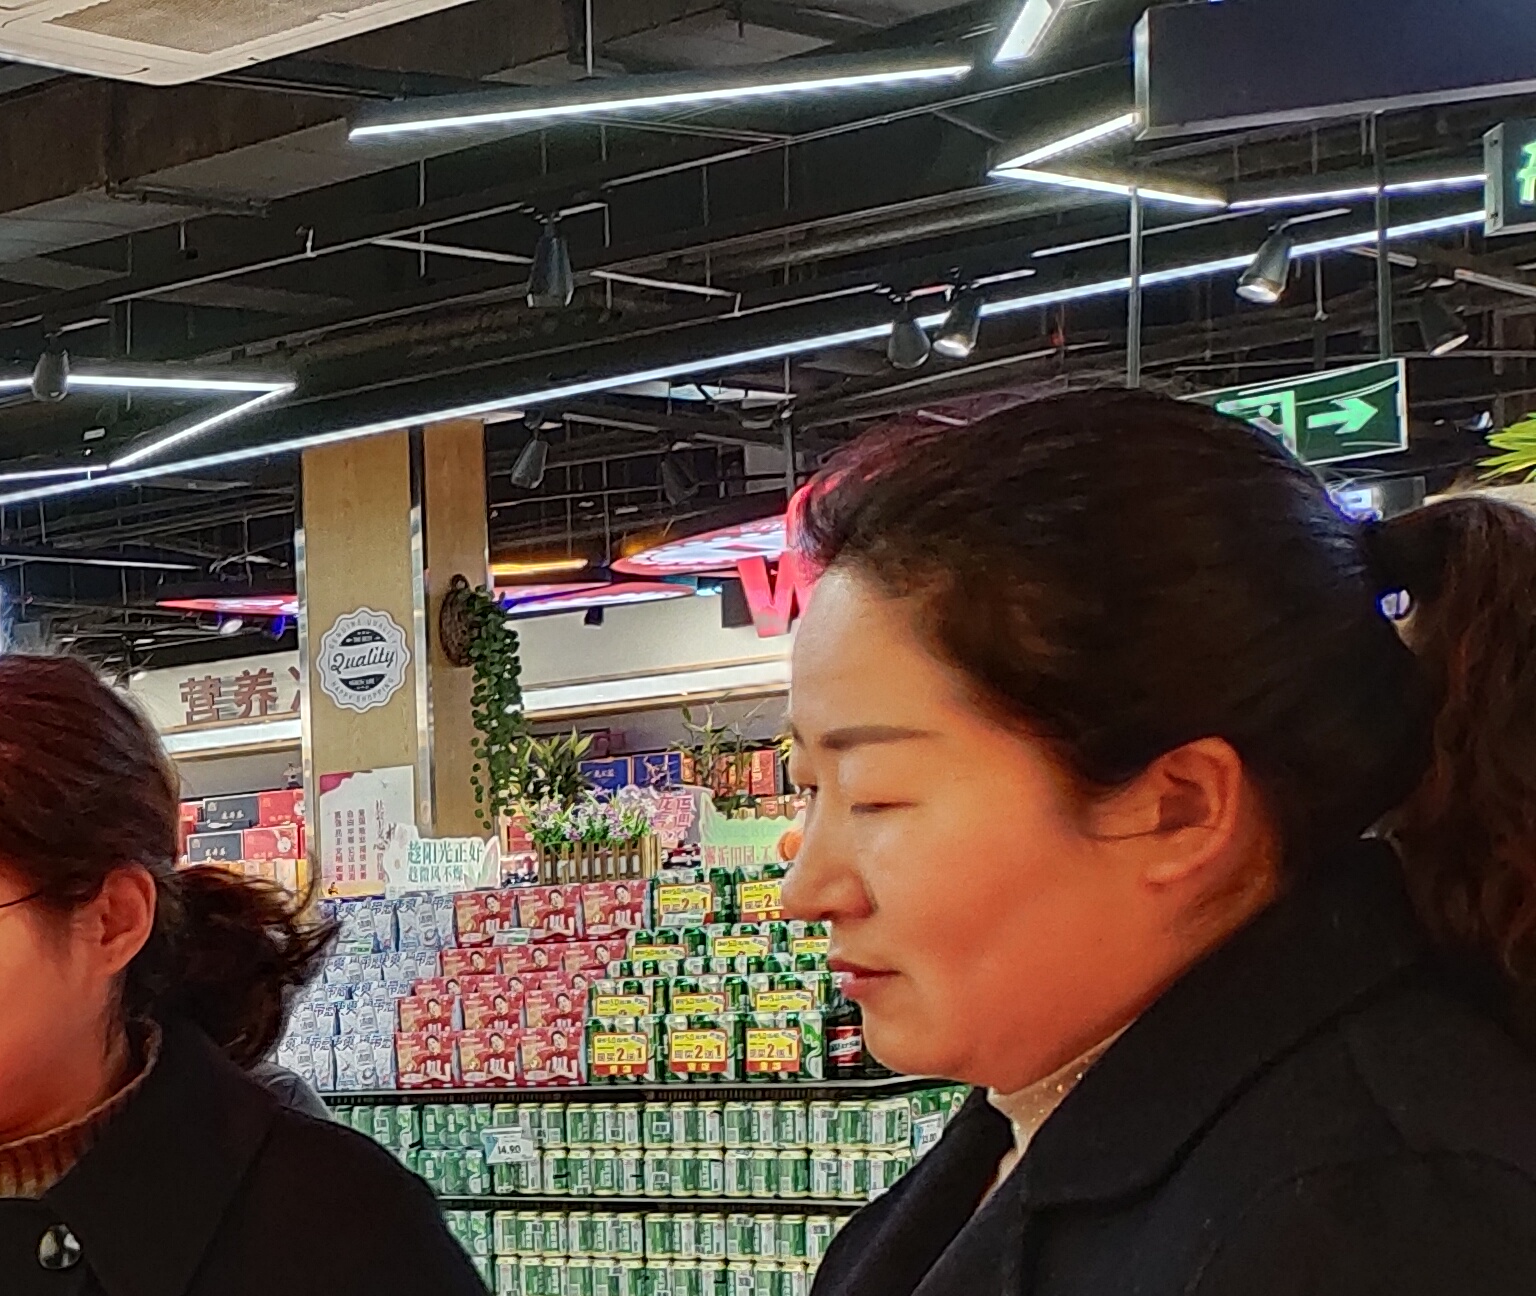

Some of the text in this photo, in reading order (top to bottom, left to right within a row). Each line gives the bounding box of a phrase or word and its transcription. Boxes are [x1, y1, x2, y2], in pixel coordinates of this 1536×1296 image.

[330, 646, 396, 675] Quality
[179, 665, 300, 725] 营养
[407, 840, 483, 865] 趁阳光正好
